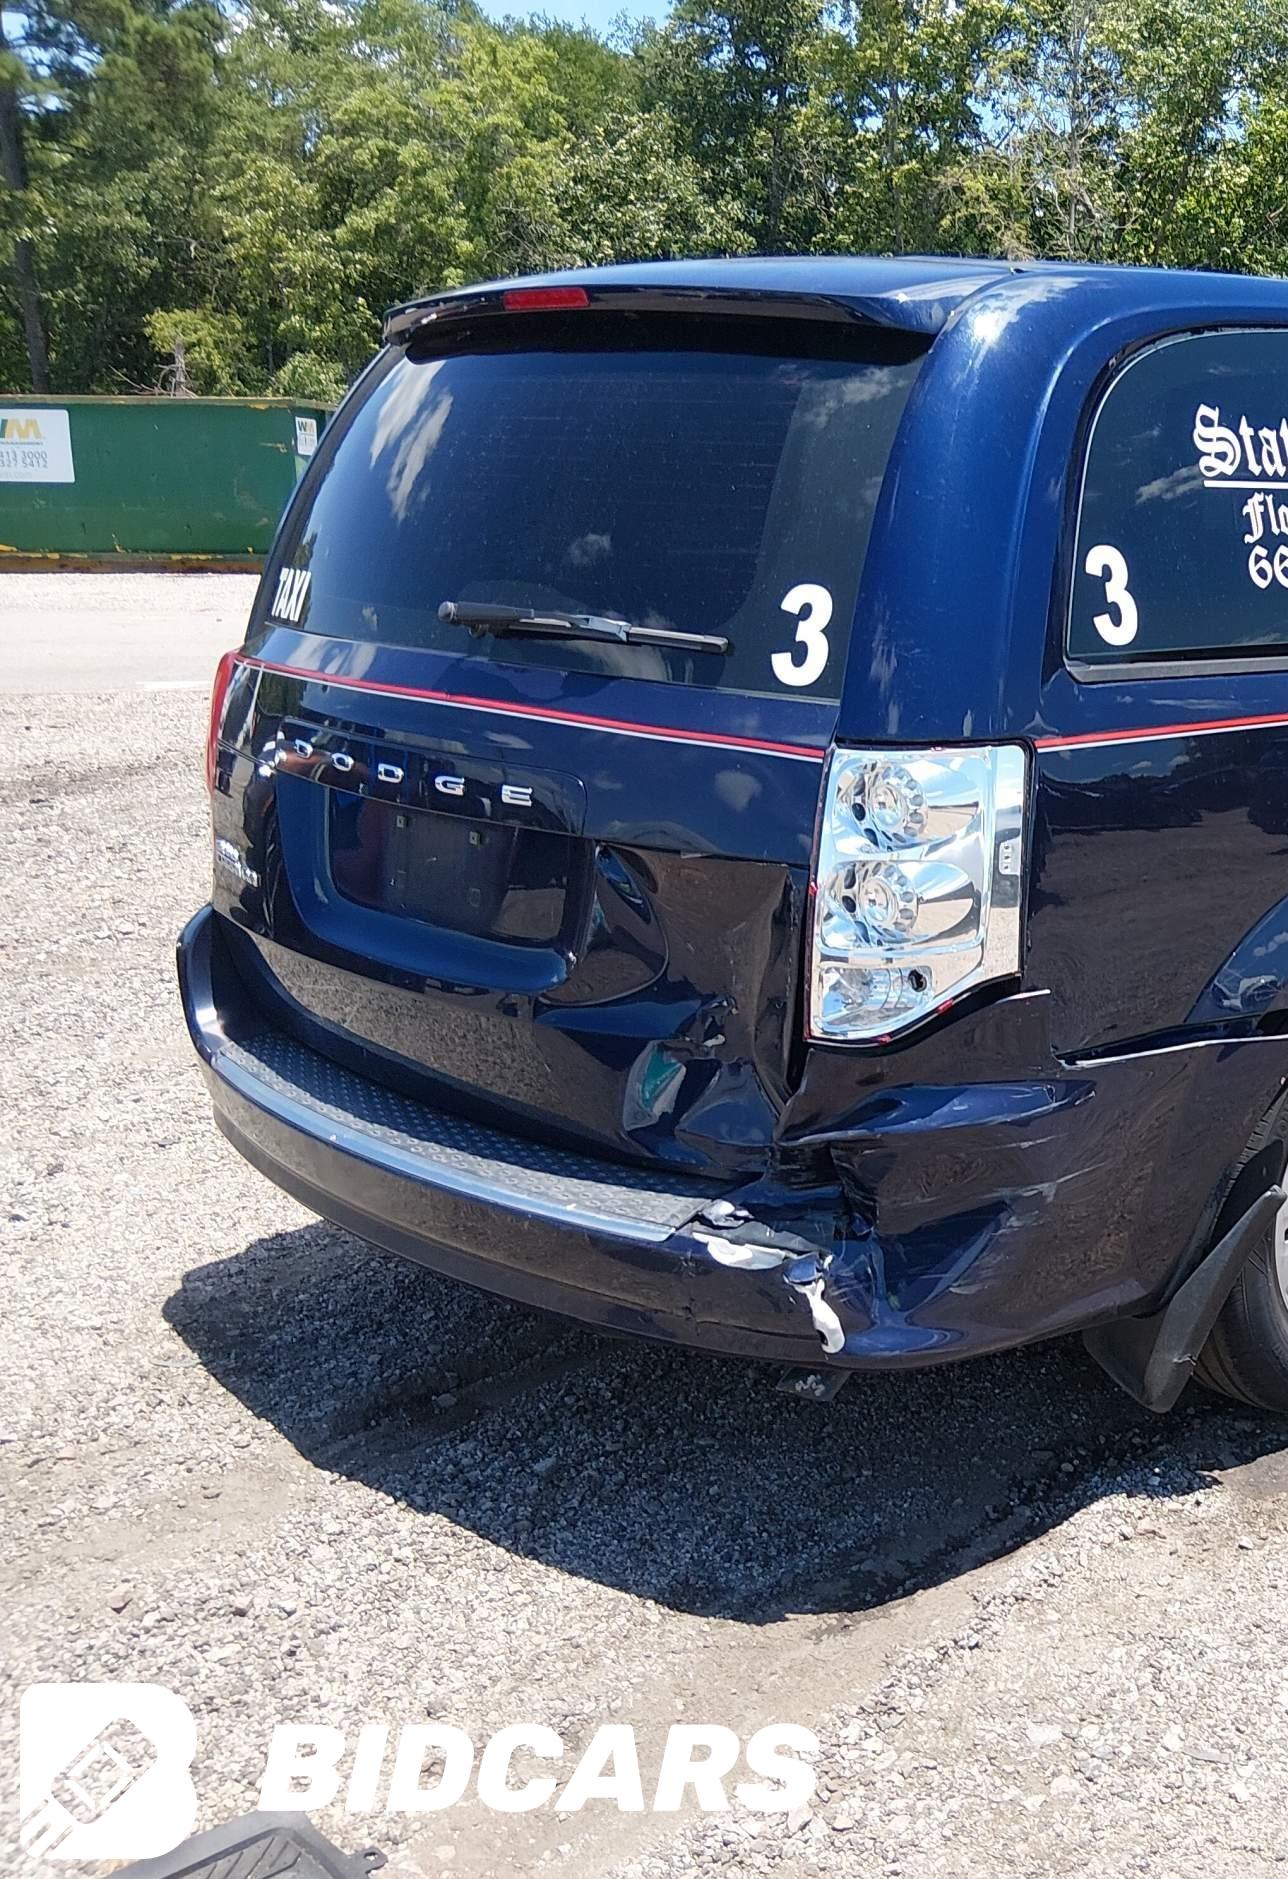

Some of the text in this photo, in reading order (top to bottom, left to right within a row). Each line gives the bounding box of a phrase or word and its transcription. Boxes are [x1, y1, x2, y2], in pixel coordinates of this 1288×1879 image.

[271, 567, 312, 622] TAXI
[771, 583, 833, 686] 3
[1085, 544, 1138, 646] 3
[294, 738, 533, 807] DODGE
